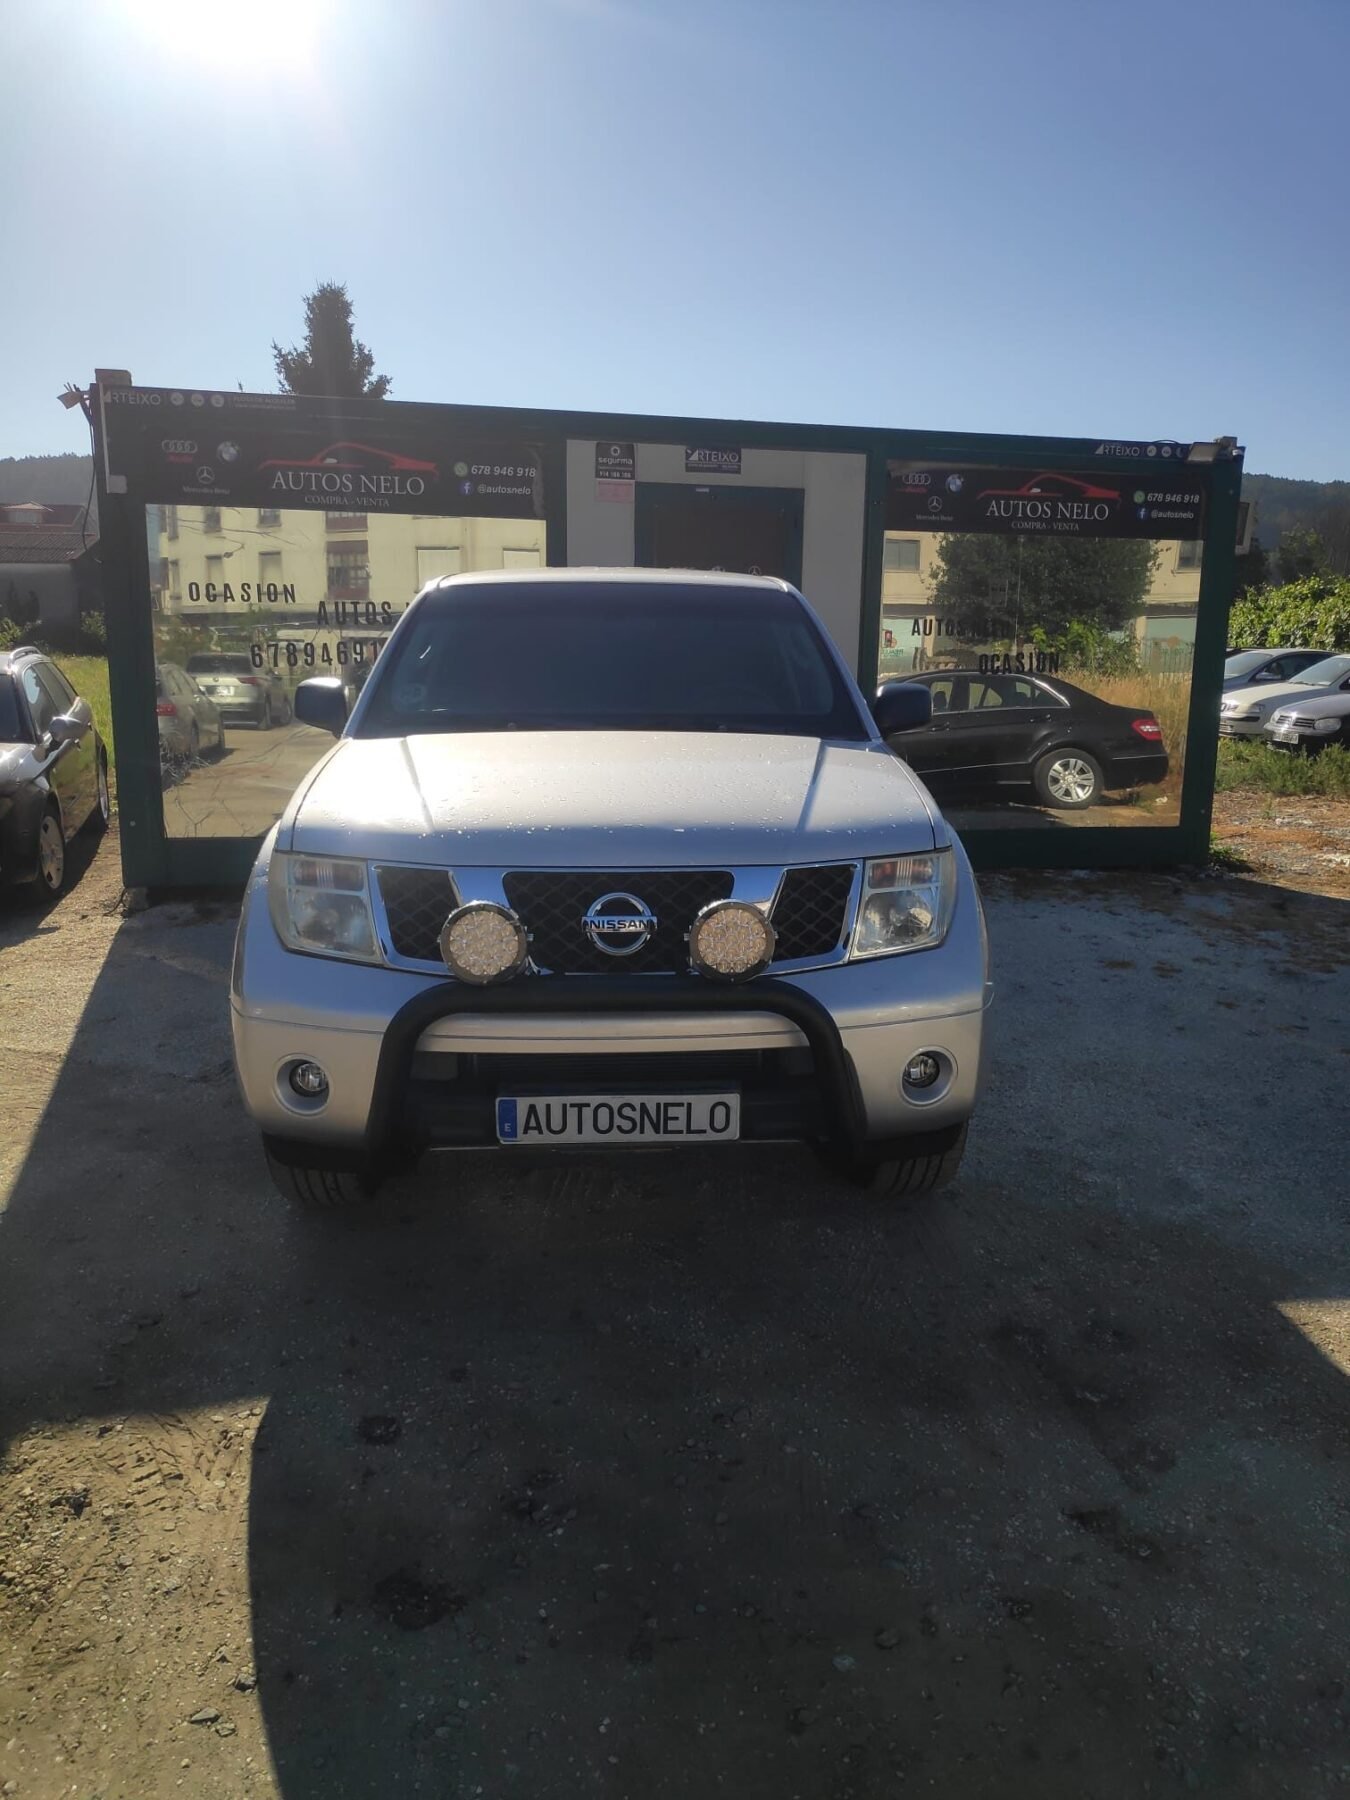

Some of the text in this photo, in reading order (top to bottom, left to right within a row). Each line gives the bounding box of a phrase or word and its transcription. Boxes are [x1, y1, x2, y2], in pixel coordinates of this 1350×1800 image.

[471, 464, 537, 478] 678 946 918
[272, 471, 425, 496] AUTOS NELO
[477, 484, 531, 496] @autosnelo
[304, 495, 390, 508] COMPRA VENTA
[1147, 493, 1200, 504] 678 946 918
[986, 499, 1109, 520] AUTOS NELO
[1151, 508, 1194, 519] @autosnelo
[1011, 520, 1079, 531] COMPRA VENTA
[188, 581, 296, 604] OCASION
[317, 600, 392, 626] AUTOS
[979, 651, 1060, 675] OCASION
[589, 919, 648, 930] NISSAN
[504, 1101, 731, 1136] E AUTOSNELO
